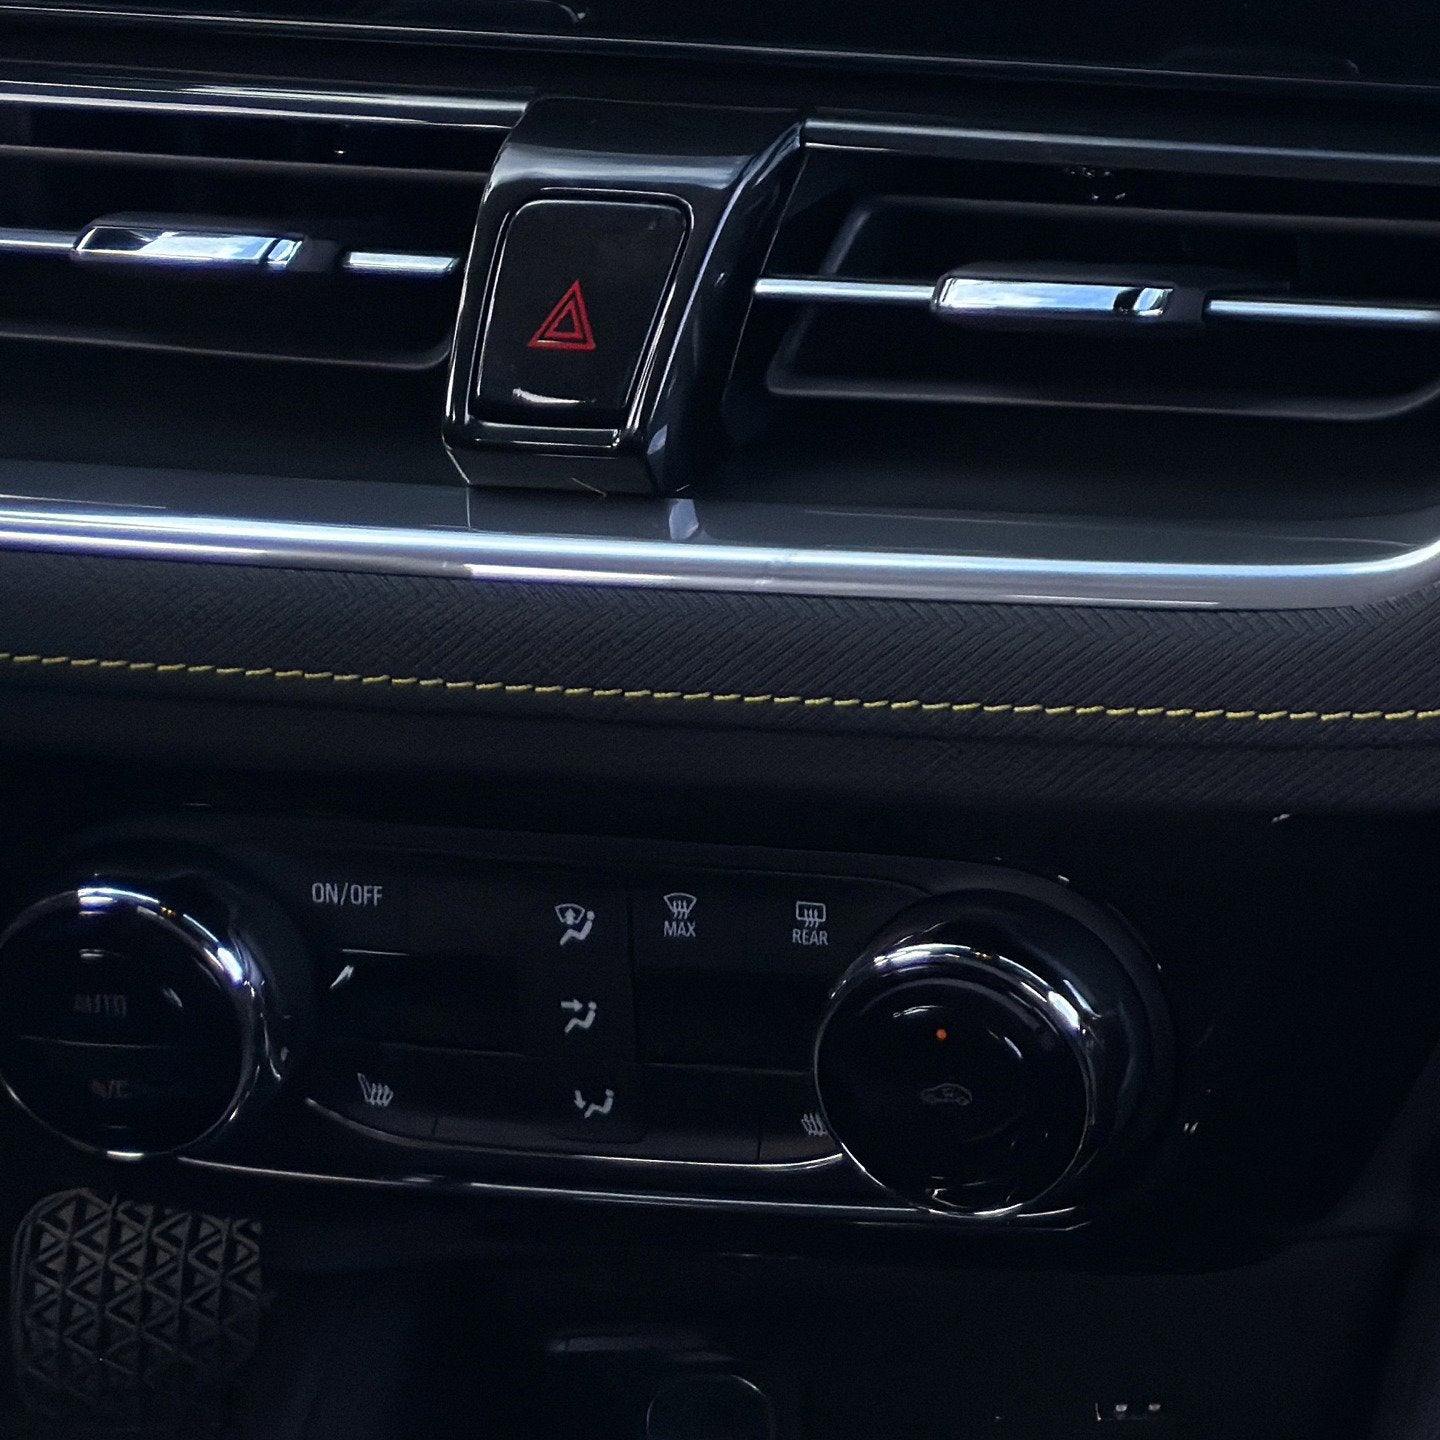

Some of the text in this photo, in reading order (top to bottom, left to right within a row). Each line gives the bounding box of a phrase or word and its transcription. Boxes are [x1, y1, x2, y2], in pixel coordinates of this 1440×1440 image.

[311, 882, 383, 906] ON/OFF
[663, 920, 696, 938] MAX
[791, 927, 829, 946] REAR
